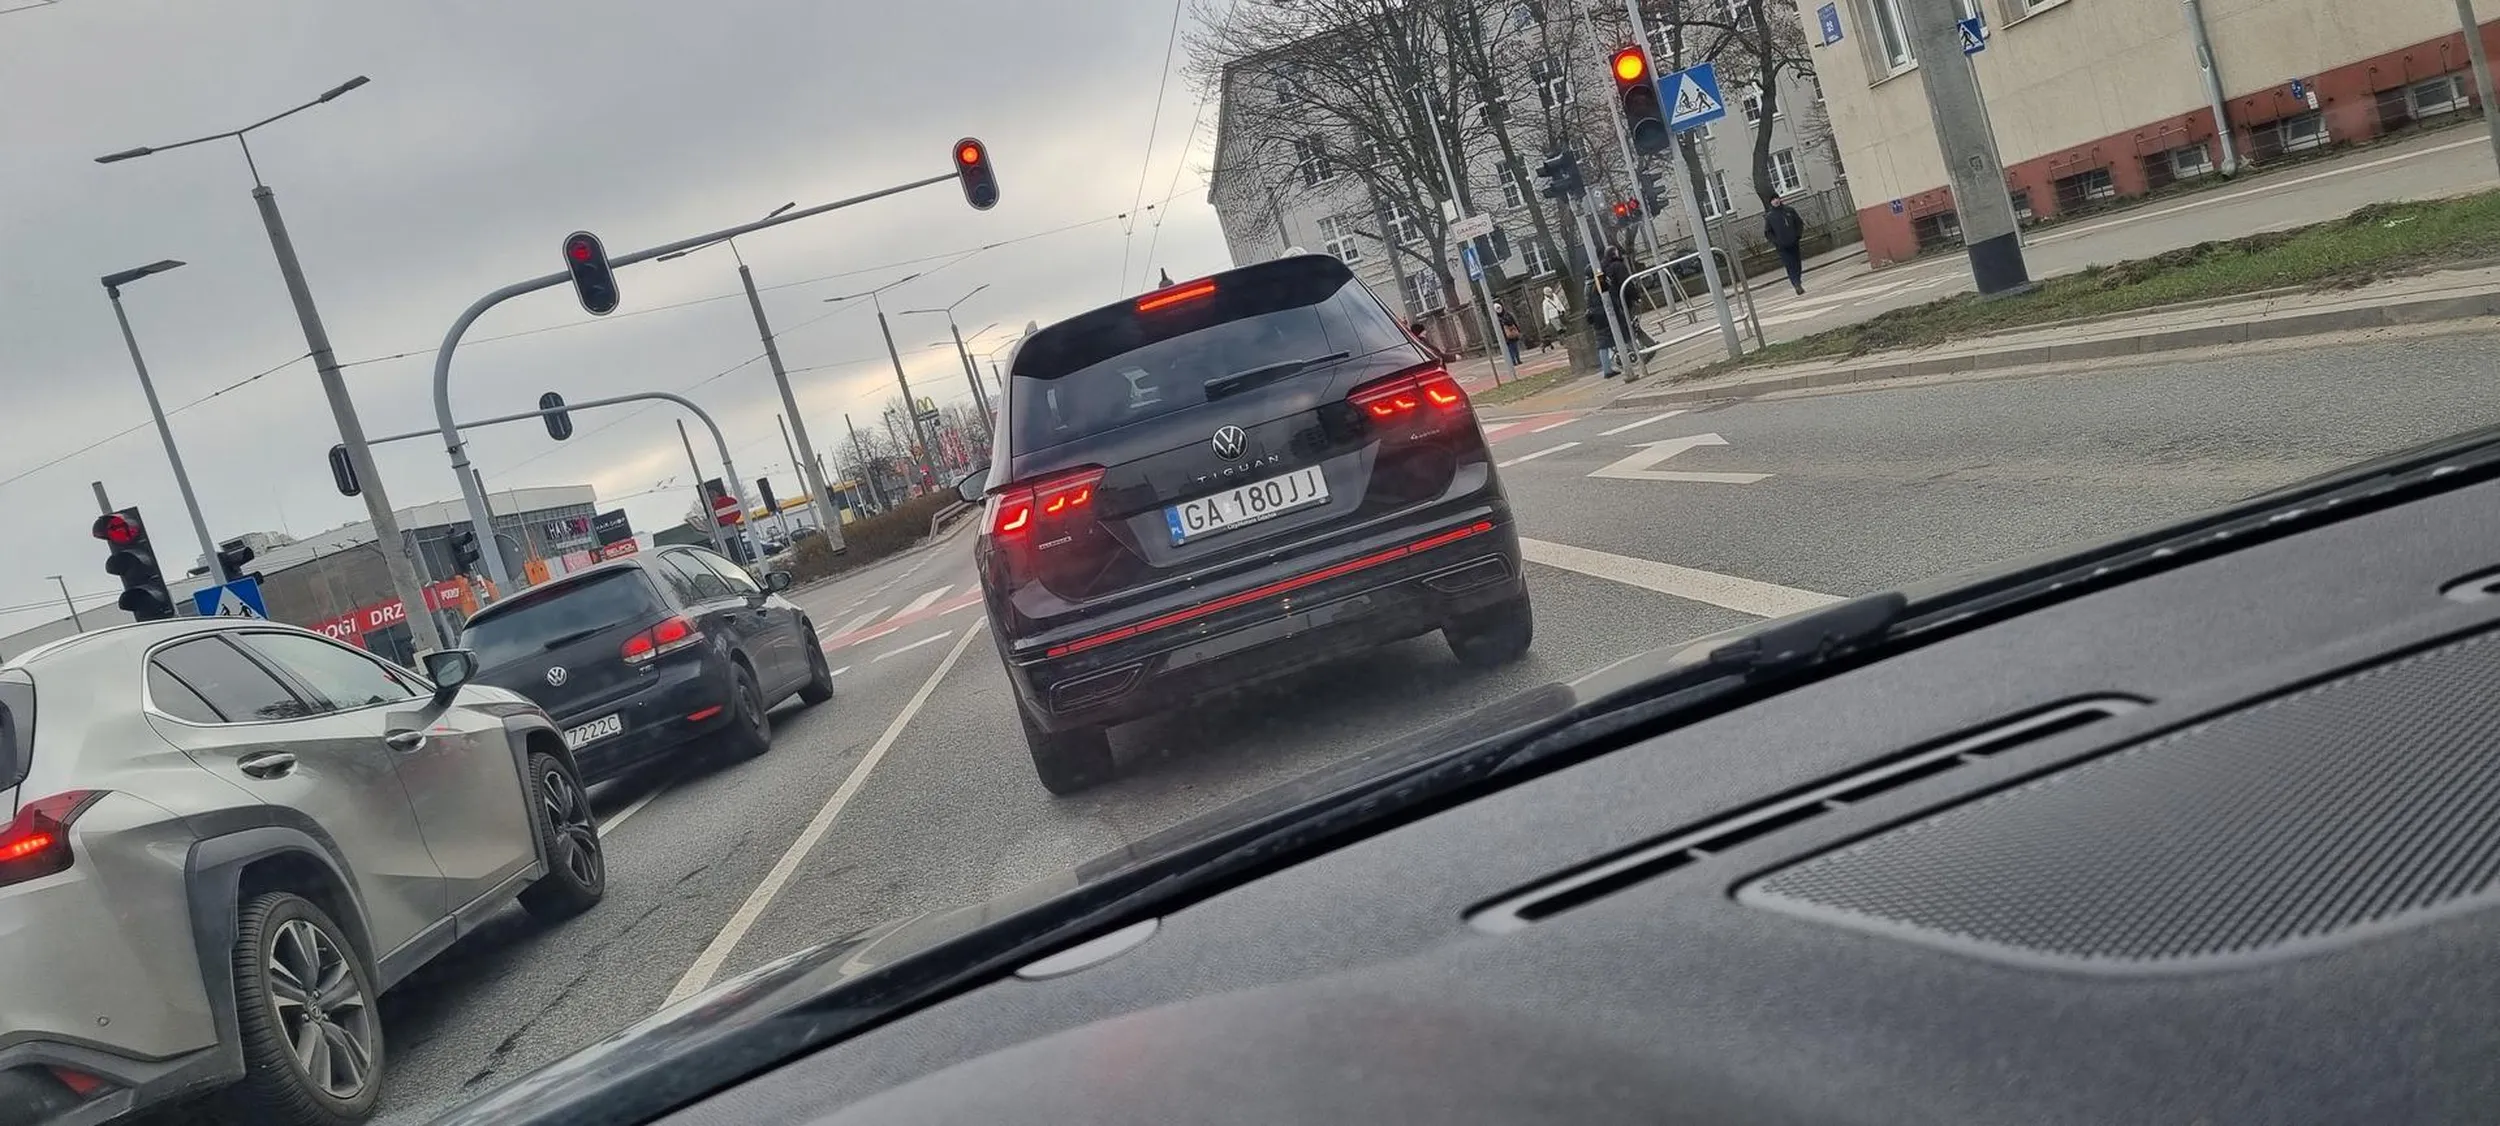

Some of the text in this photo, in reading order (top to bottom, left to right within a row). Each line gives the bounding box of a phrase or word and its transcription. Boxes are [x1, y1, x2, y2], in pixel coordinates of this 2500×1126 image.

[1197, 454, 1280, 483] TIGUAN
[1184, 470, 1317, 531] GA 180JJ
[316, 603, 405, 638] OGI DRZ
[568, 717, 619, 746] 7222C
